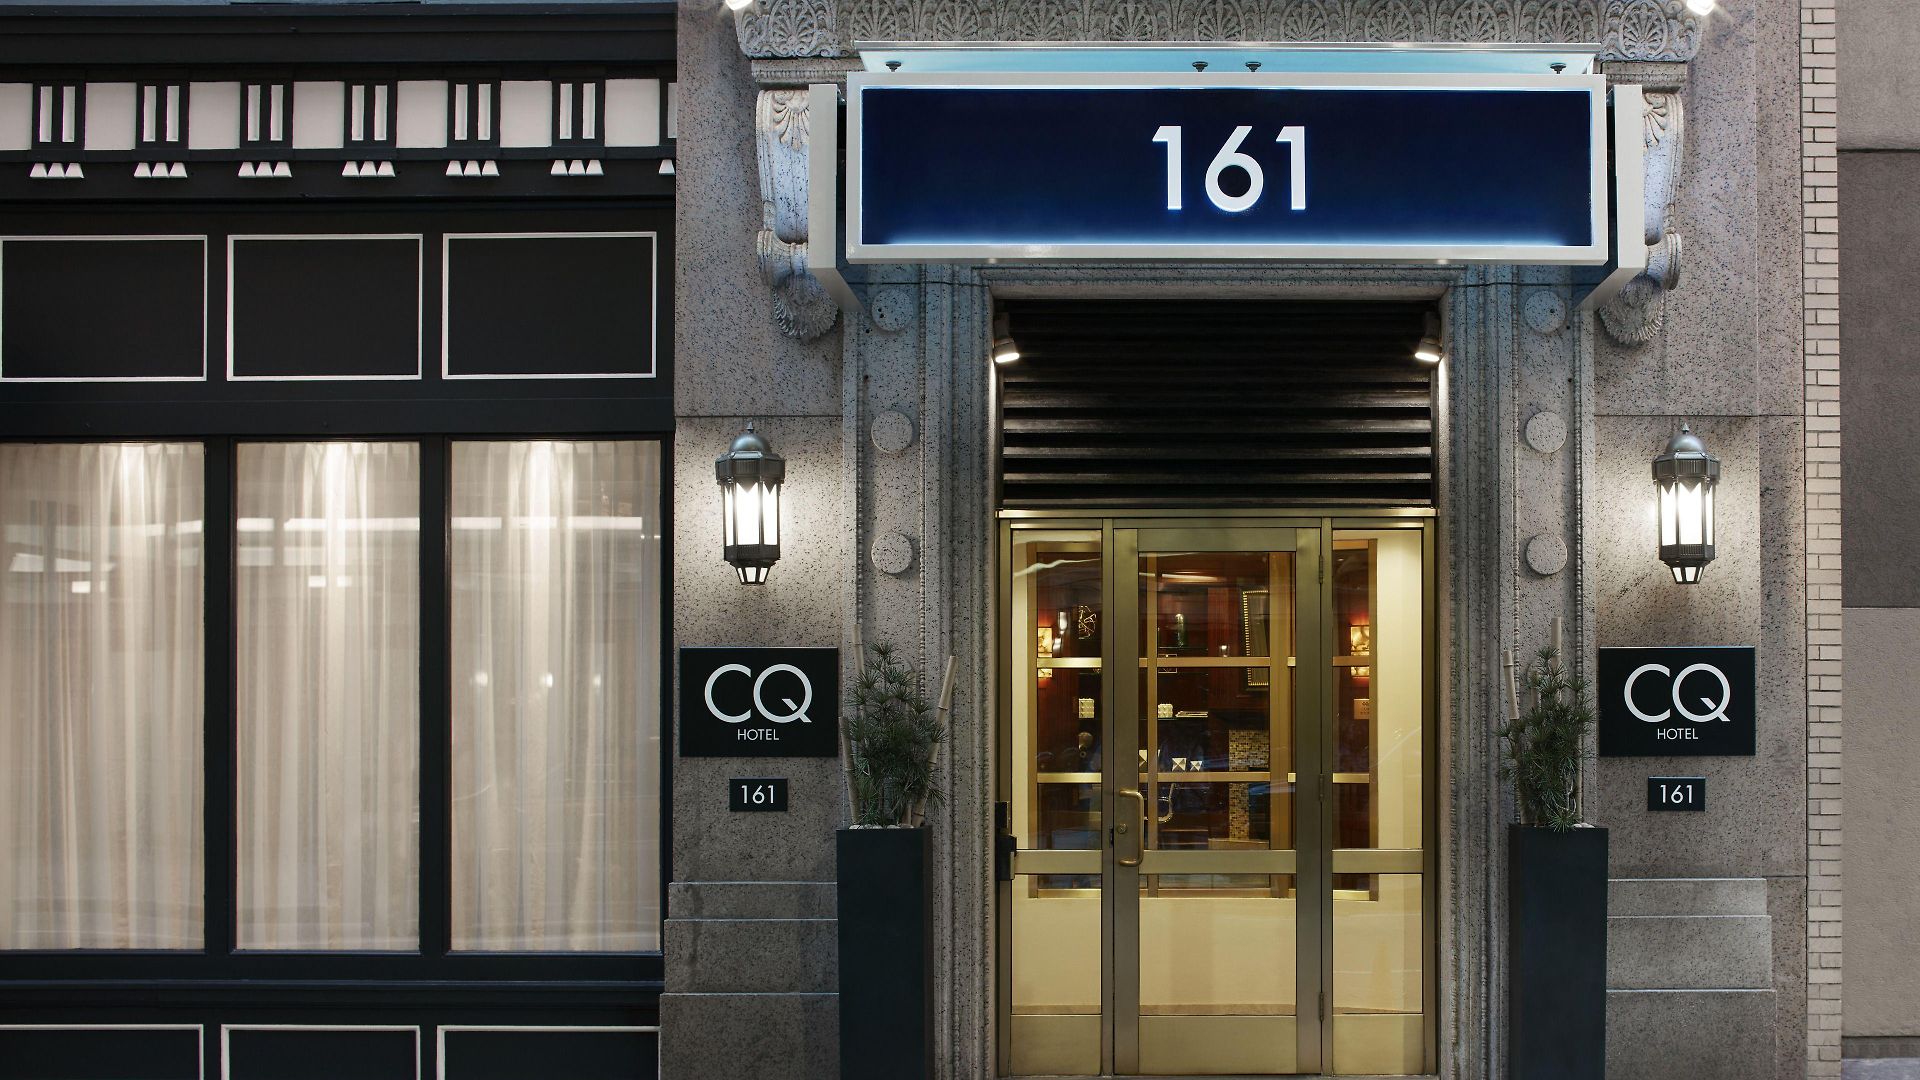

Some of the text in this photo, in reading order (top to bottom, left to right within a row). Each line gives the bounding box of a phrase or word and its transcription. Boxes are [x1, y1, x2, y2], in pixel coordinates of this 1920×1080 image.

[1152, 126, 1307, 212] 161
[704, 663, 813, 723] CQ
[1623, 663, 1731, 723] CQ
[737, 728, 780, 741] HOTEL
[1657, 728, 1699, 740] HOTEL
[741, 784, 775, 804] 161
[1660, 784, 1693, 804] 161
